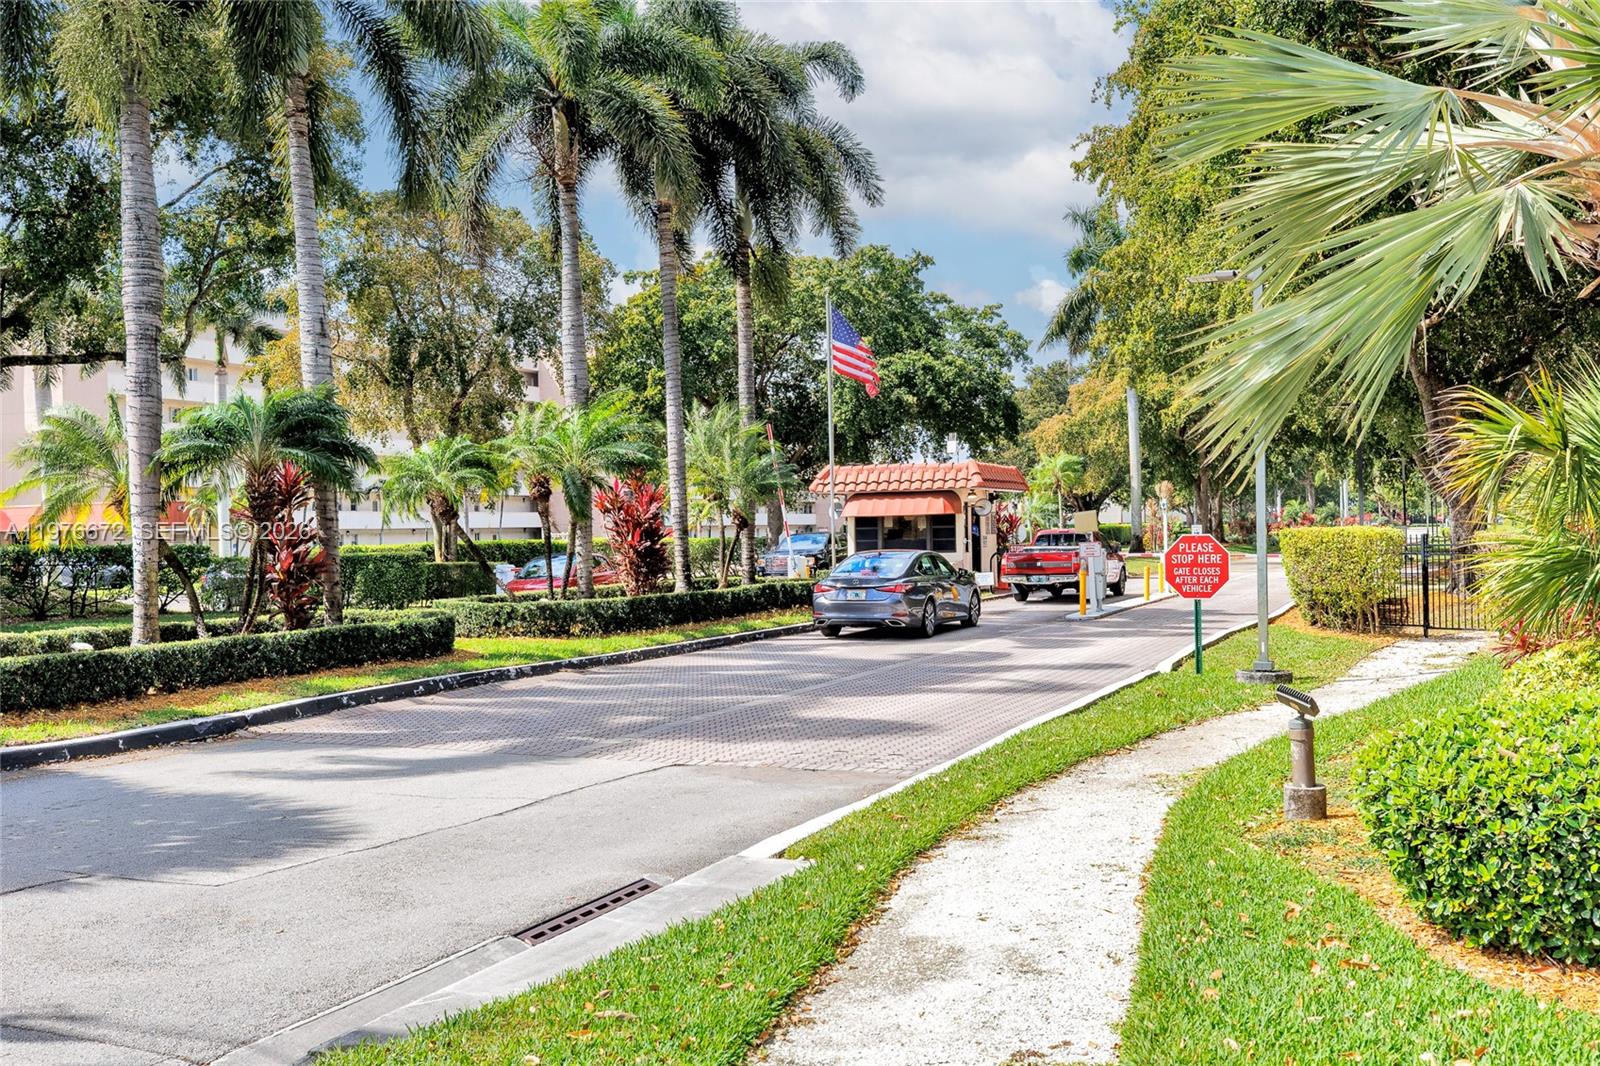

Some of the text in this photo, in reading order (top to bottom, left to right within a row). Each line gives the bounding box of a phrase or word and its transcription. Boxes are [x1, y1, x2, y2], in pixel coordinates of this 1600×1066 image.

[1179, 543, 1214, 552] PLEASE
[1171, 554, 1222, 564] STOP HERE
[1173, 567, 1221, 575] GATE CLOSES
